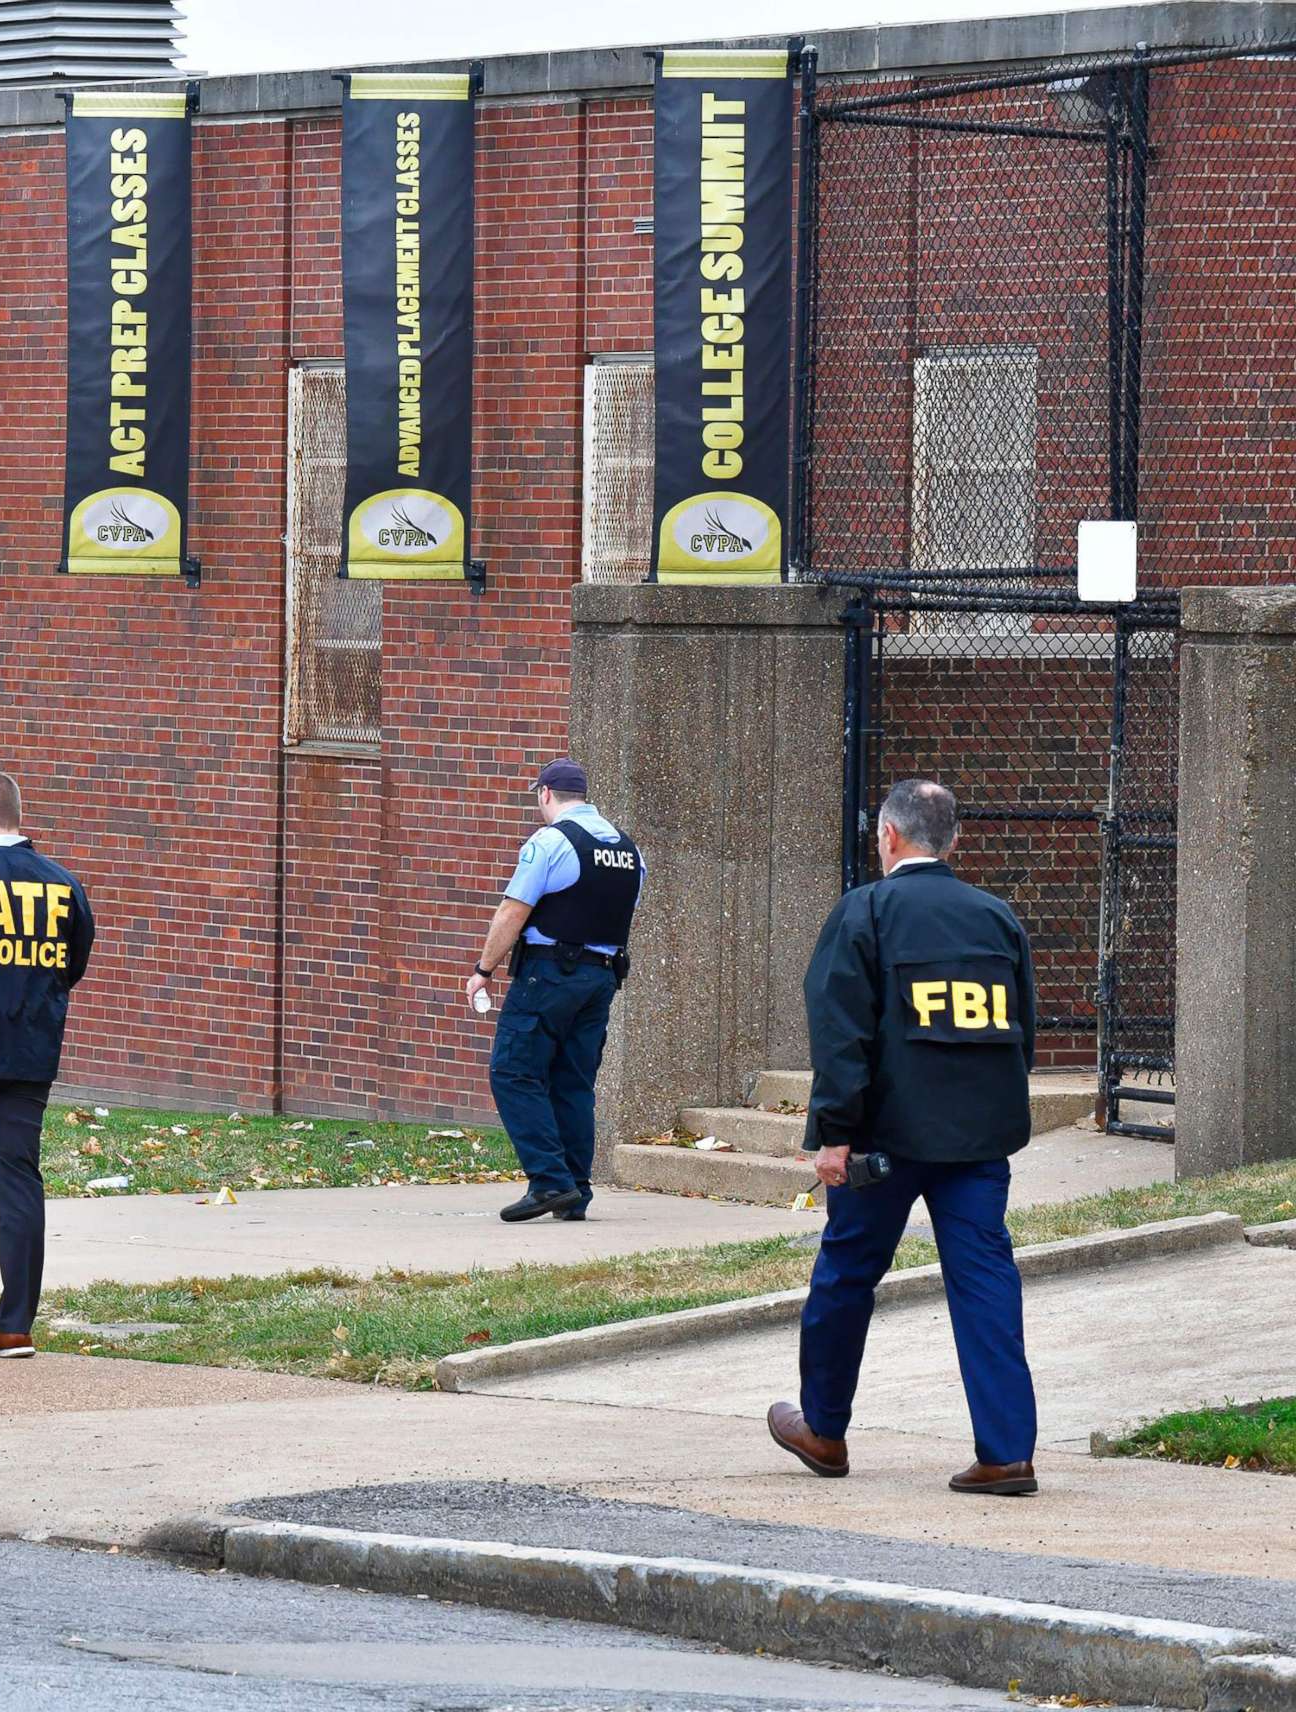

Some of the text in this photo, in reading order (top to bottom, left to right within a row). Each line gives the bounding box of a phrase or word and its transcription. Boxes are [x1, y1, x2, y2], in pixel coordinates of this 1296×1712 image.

[109, 127, 147, 477] ACT PREP CLASSES
[396, 112, 421, 477] ADVANCED PLACEMENT CLASSES
[700, 93, 745, 479] COLLEGE SUMMIT
[97, 525, 146, 542] CVPA
[378, 528, 428, 546] CVPA
[690, 534, 743, 553] CVPA
[593, 849, 635, 870] POLICE
[911, 980, 1010, 1031] FBI
